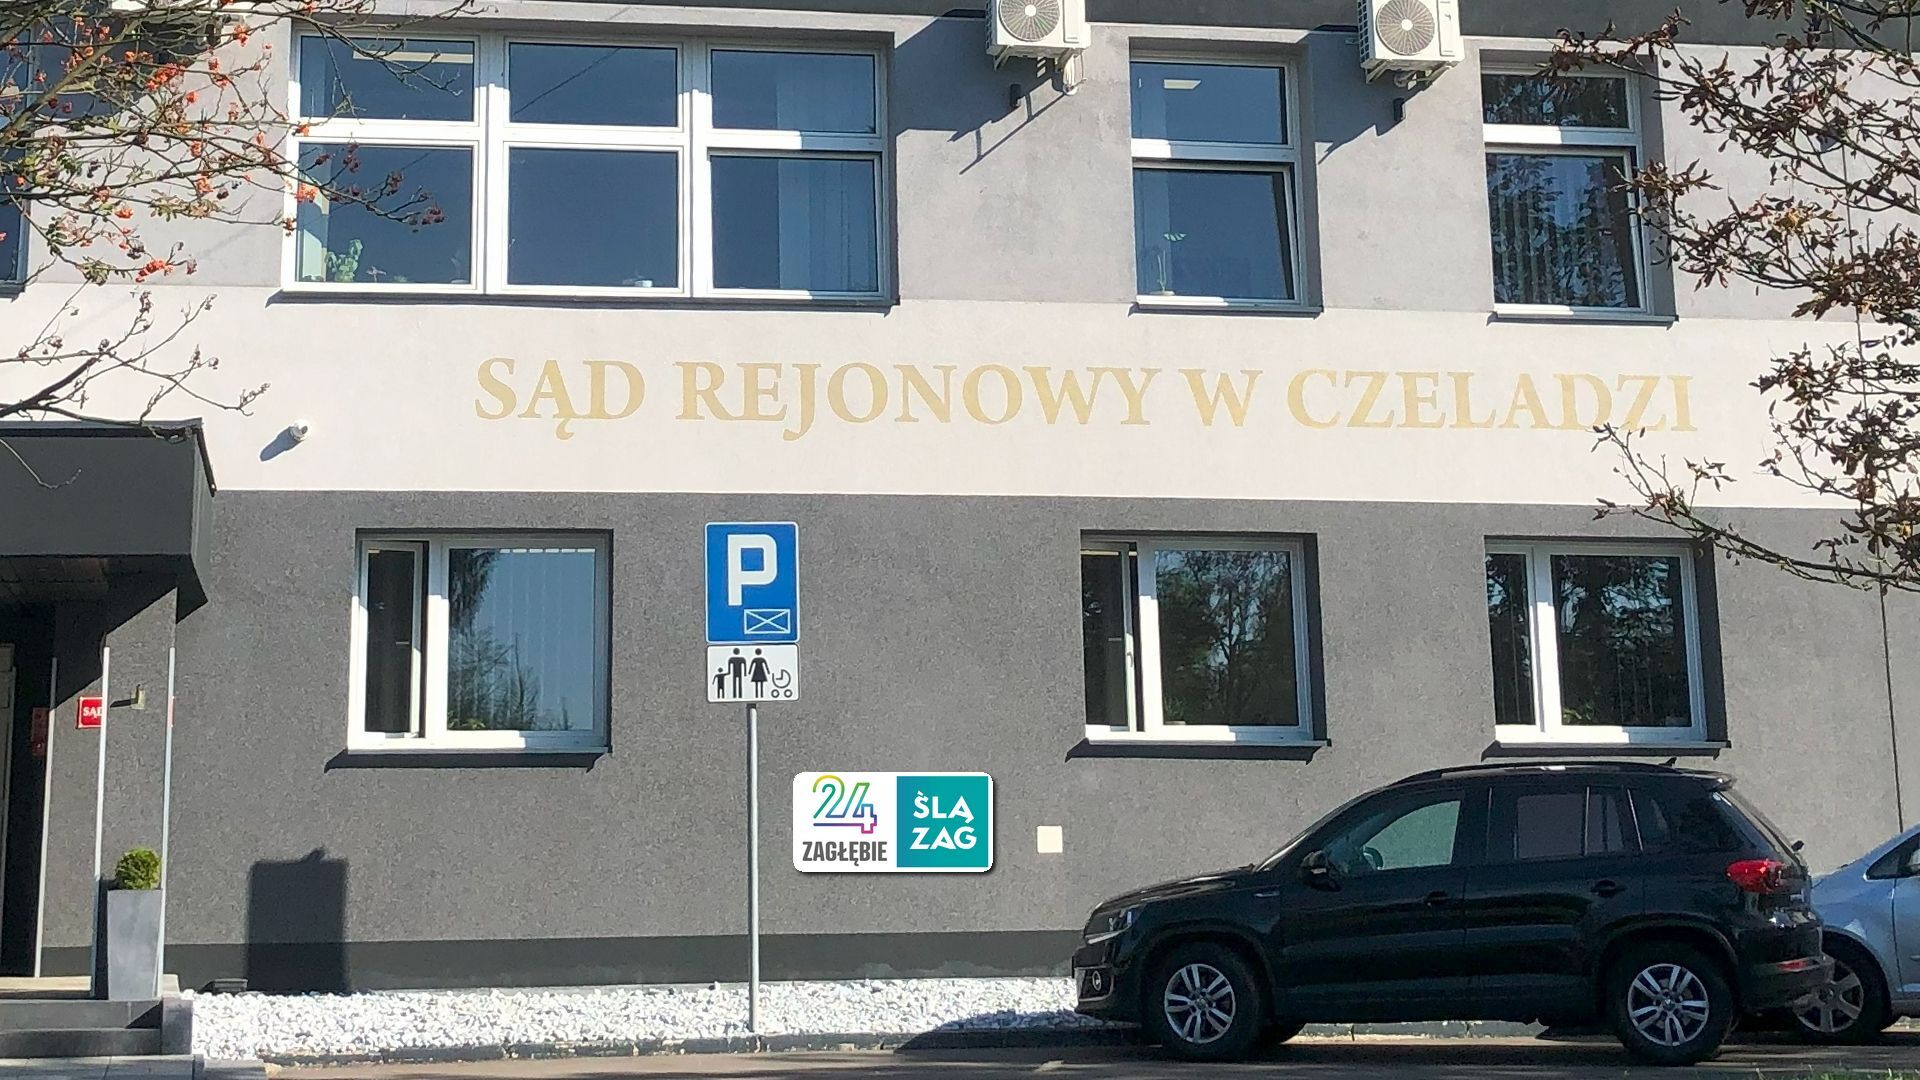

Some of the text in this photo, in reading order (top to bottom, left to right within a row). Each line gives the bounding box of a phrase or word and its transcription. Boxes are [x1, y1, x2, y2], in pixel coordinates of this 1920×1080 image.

[474, 357, 1698, 441] SĄD REJONOWY W CZELADZI
[727, 533, 777, 606] P
